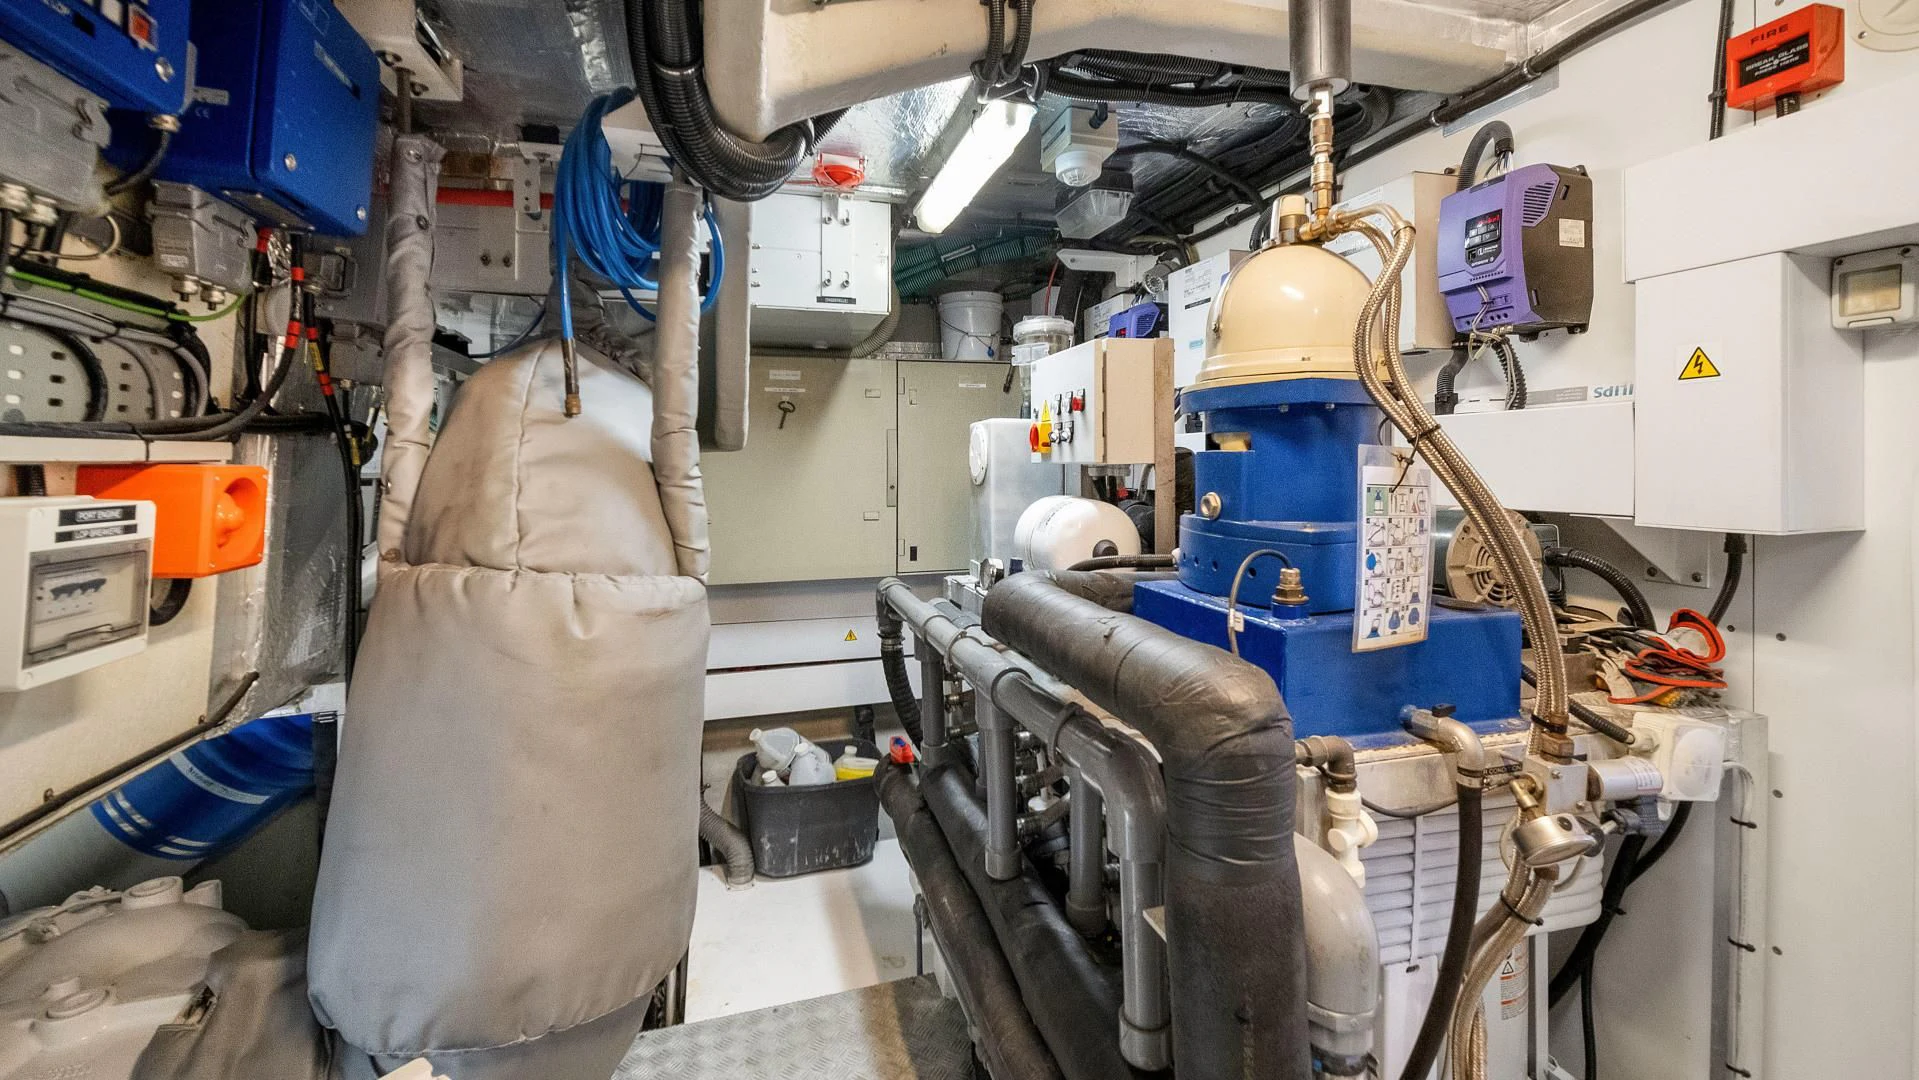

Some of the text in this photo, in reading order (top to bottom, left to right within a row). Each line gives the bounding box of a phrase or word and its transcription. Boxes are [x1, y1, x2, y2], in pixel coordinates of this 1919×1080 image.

[1750, 24, 1788, 45] FIRE
[1745, 43, 1809, 71] BREAK GLASS
